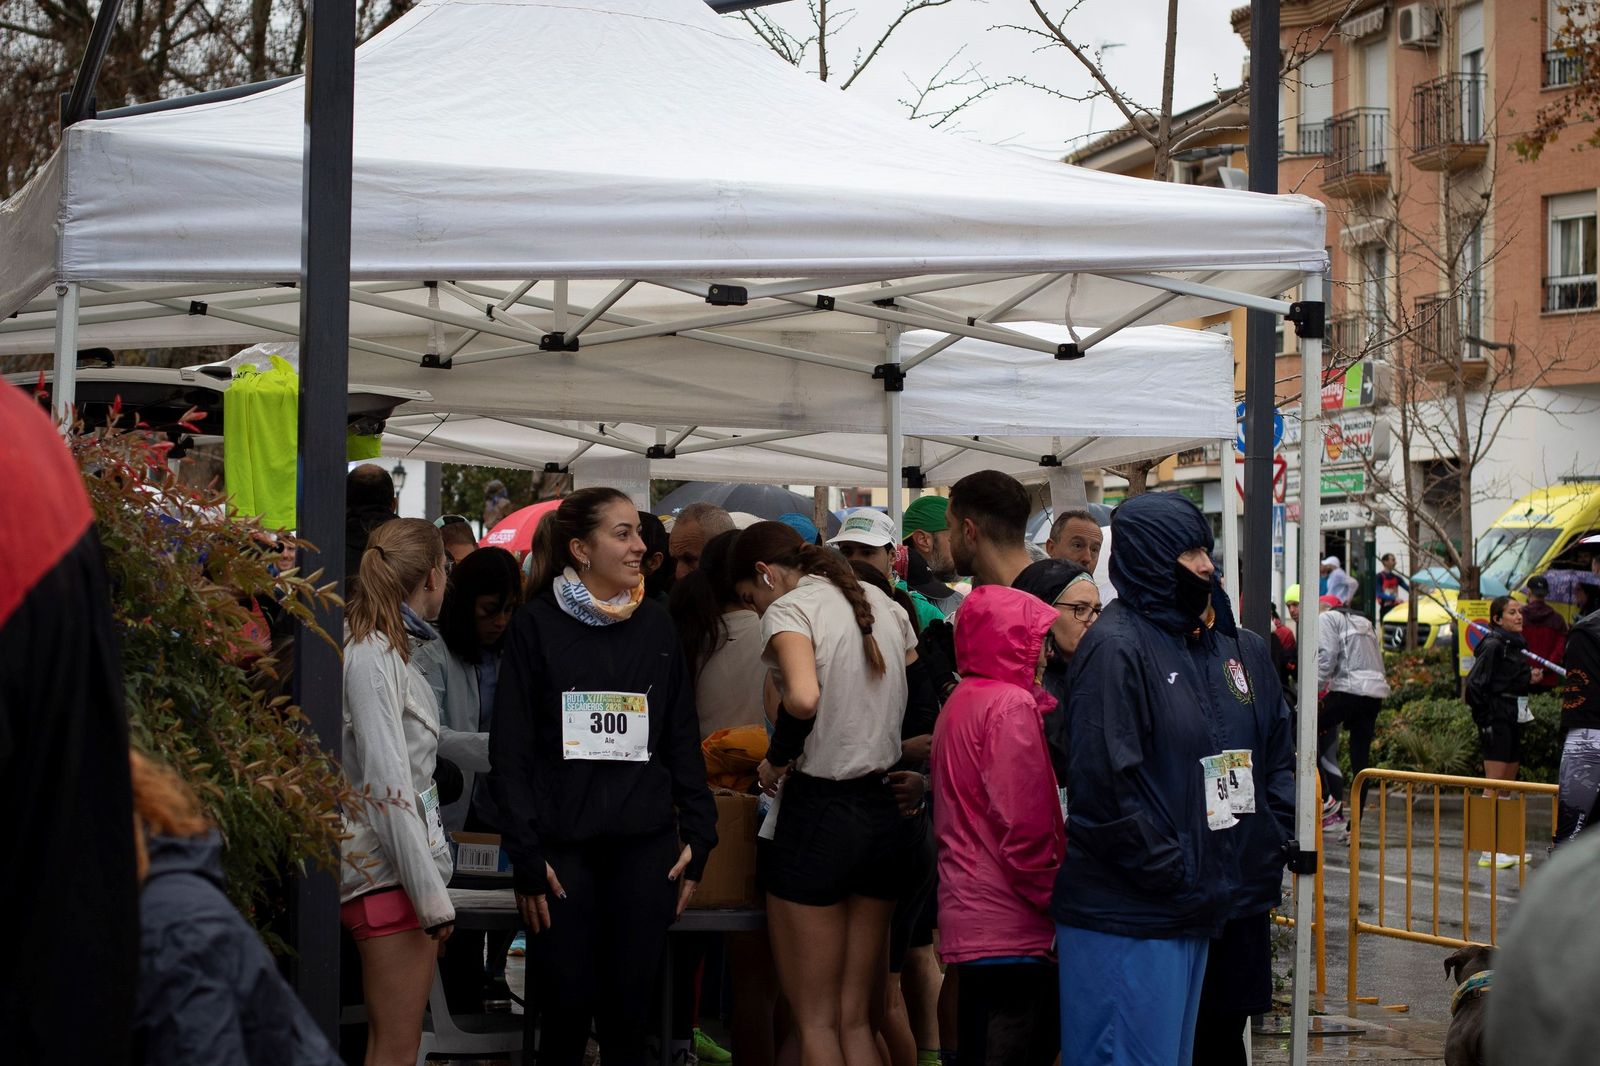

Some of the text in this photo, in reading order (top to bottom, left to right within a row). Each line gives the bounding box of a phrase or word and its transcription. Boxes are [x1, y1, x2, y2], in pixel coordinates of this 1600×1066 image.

[562, 582, 577, 609] RUTA
[567, 694, 585, 702] RUTA
[567, 702, 604, 711] SECADEROS
[590, 712, 627, 734] 300
